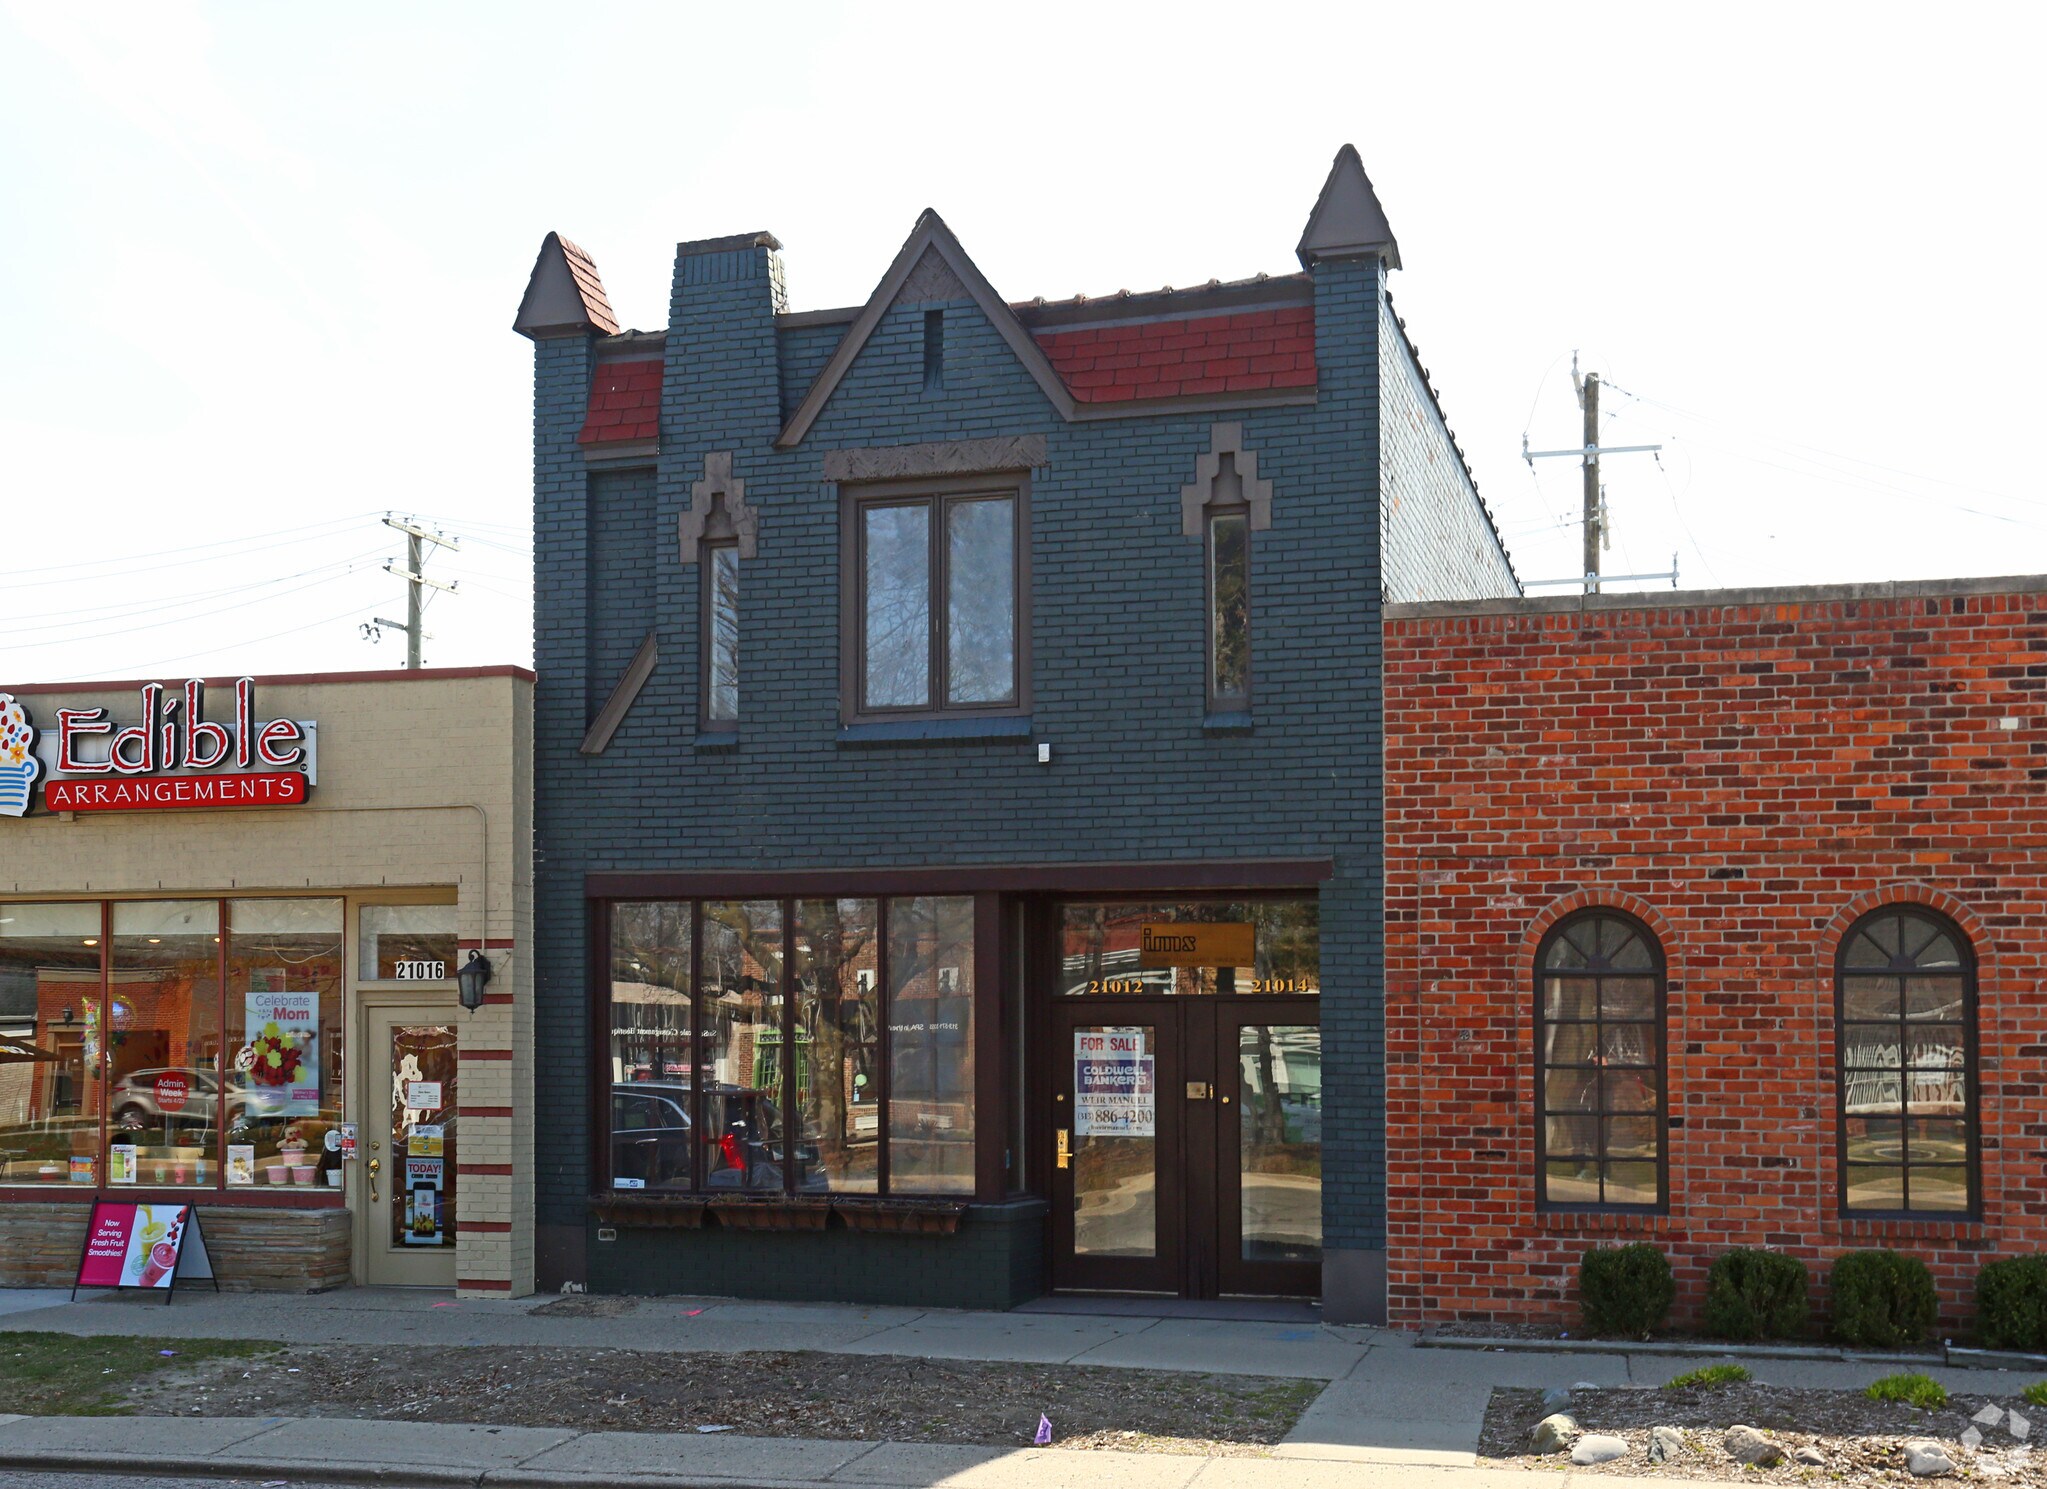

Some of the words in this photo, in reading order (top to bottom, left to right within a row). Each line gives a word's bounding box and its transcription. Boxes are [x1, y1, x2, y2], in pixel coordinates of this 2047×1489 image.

[55, 676, 305, 774] Edible
[53, 777, 295, 805] ARRANGEMENTS
[397, 961, 443, 979] 21016
[1089, 980, 1143, 993] 21012
[1251, 978, 1308, 992] 21014
[255, 994, 311, 1007] Celebrate
[273, 1007, 310, 1020] Mom
[1080, 1037, 1104, 1051] FOR
[157, 1079, 186, 1088] Admin.
[160, 1088, 183, 1097] Week
[1095, 1109, 1153, 1123] 886-4200
[408, 1163, 442, 1173] TODAY!
[104, 1219, 120, 1227] Now
[97, 1229, 122, 1238] Serving
[91, 1239, 109, 1247] Fresh
[109, 1239, 125, 1247] Fruit
[88, 1248, 123, 1257] Smoothies!
